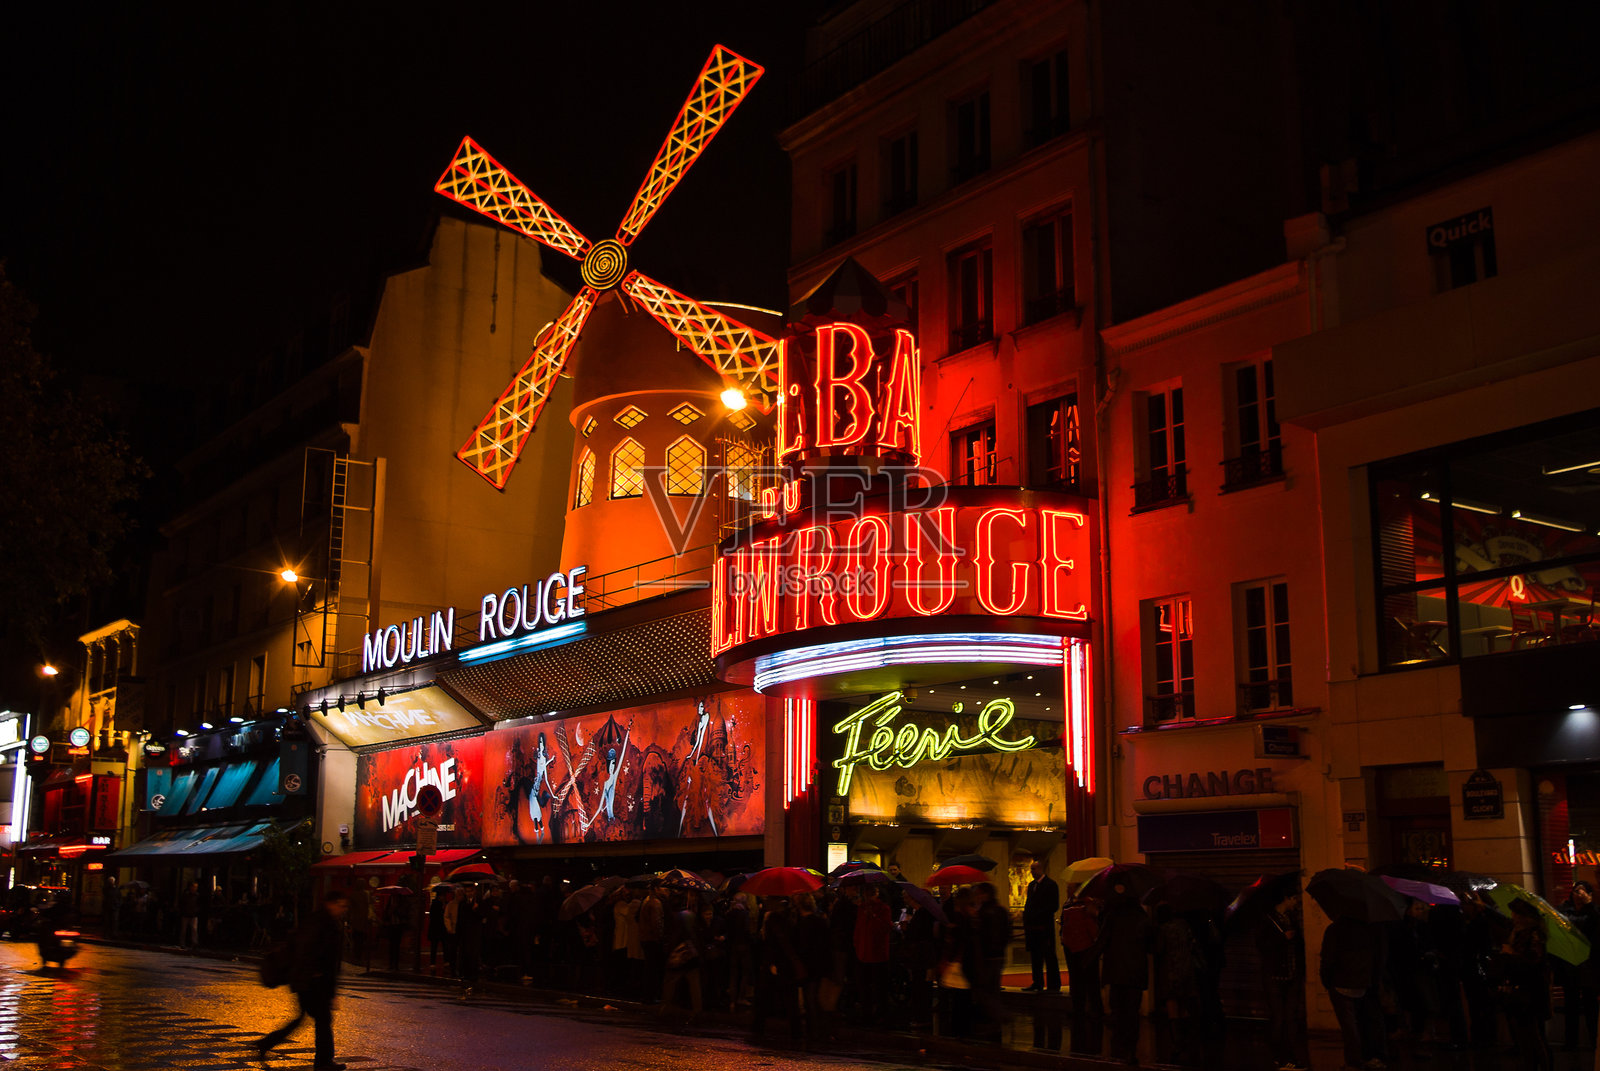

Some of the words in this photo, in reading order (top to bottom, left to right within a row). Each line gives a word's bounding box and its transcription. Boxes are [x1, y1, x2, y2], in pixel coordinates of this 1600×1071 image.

[1429, 211, 1490, 248] Quick
[814, 322, 921, 458] BA
[762, 480, 800, 519] DU
[711, 536, 781, 659] LIN
[794, 507, 1088, 631] ROUGE
[1510, 574, 1526, 601] Q
[363, 606, 455, 673] MOULIN
[480, 565, 588, 642] ROUGE
[382, 757, 457, 832] MACHINE
[1143, 767, 1274, 800] CHANGE
[93, 836, 111, 845] BAR
[1211, 832, 1257, 848] Travelex
